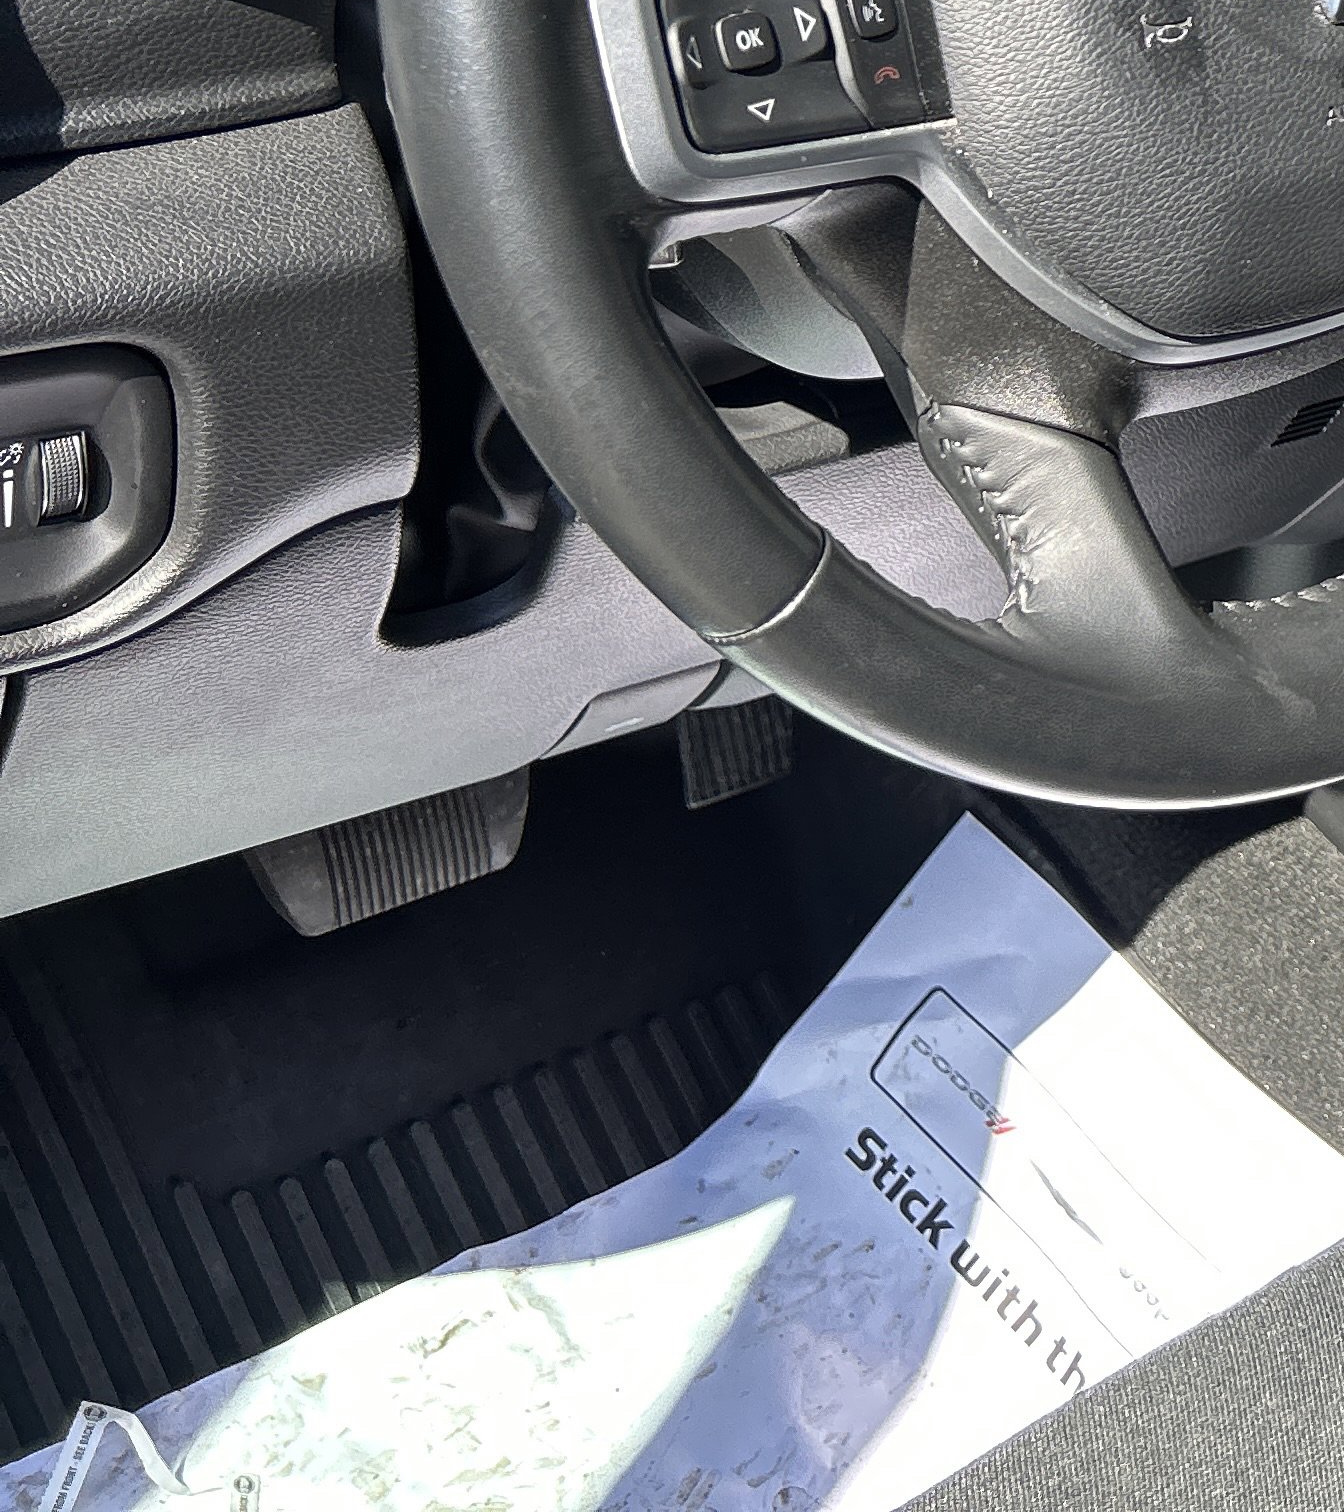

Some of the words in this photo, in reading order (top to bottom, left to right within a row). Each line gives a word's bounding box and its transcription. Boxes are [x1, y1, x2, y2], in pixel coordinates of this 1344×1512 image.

[735, 27, 763, 52] OK
[844, 1126, 956, 1250] Stick
[950, 1240, 1042, 1346] with
[1045, 1336, 1087, 1390] th
